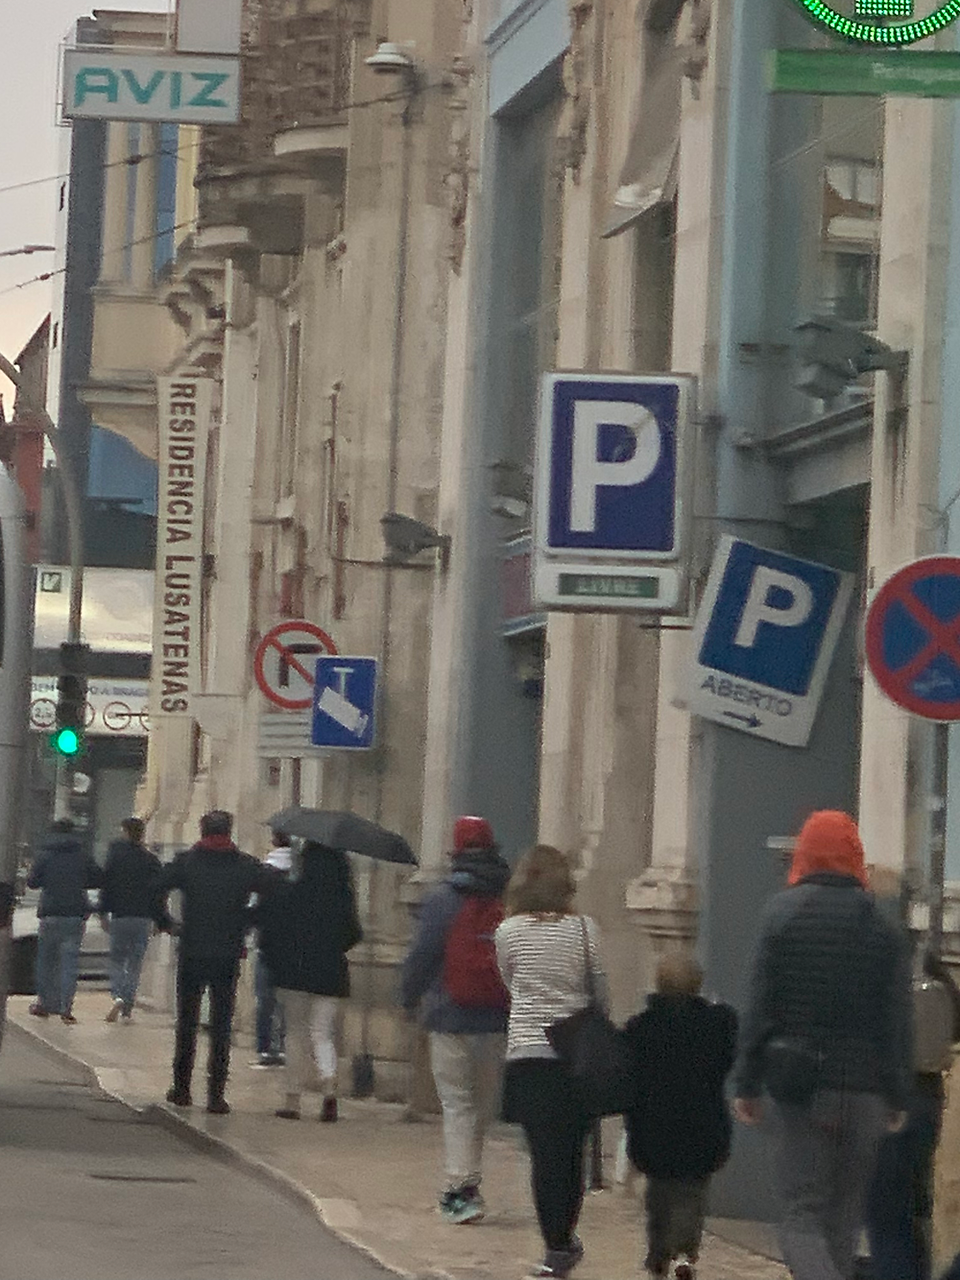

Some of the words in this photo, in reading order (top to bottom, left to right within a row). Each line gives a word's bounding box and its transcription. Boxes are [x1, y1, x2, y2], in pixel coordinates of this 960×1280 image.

[73, 66, 232, 111] AVIZ
[166, 382, 197, 544] RESIDENCIA
[569, 399, 662, 533] P
[161, 555, 195, 714] LUSATENAS
[734, 565, 816, 648] P
[701, 675, 792, 717] ABERTO
